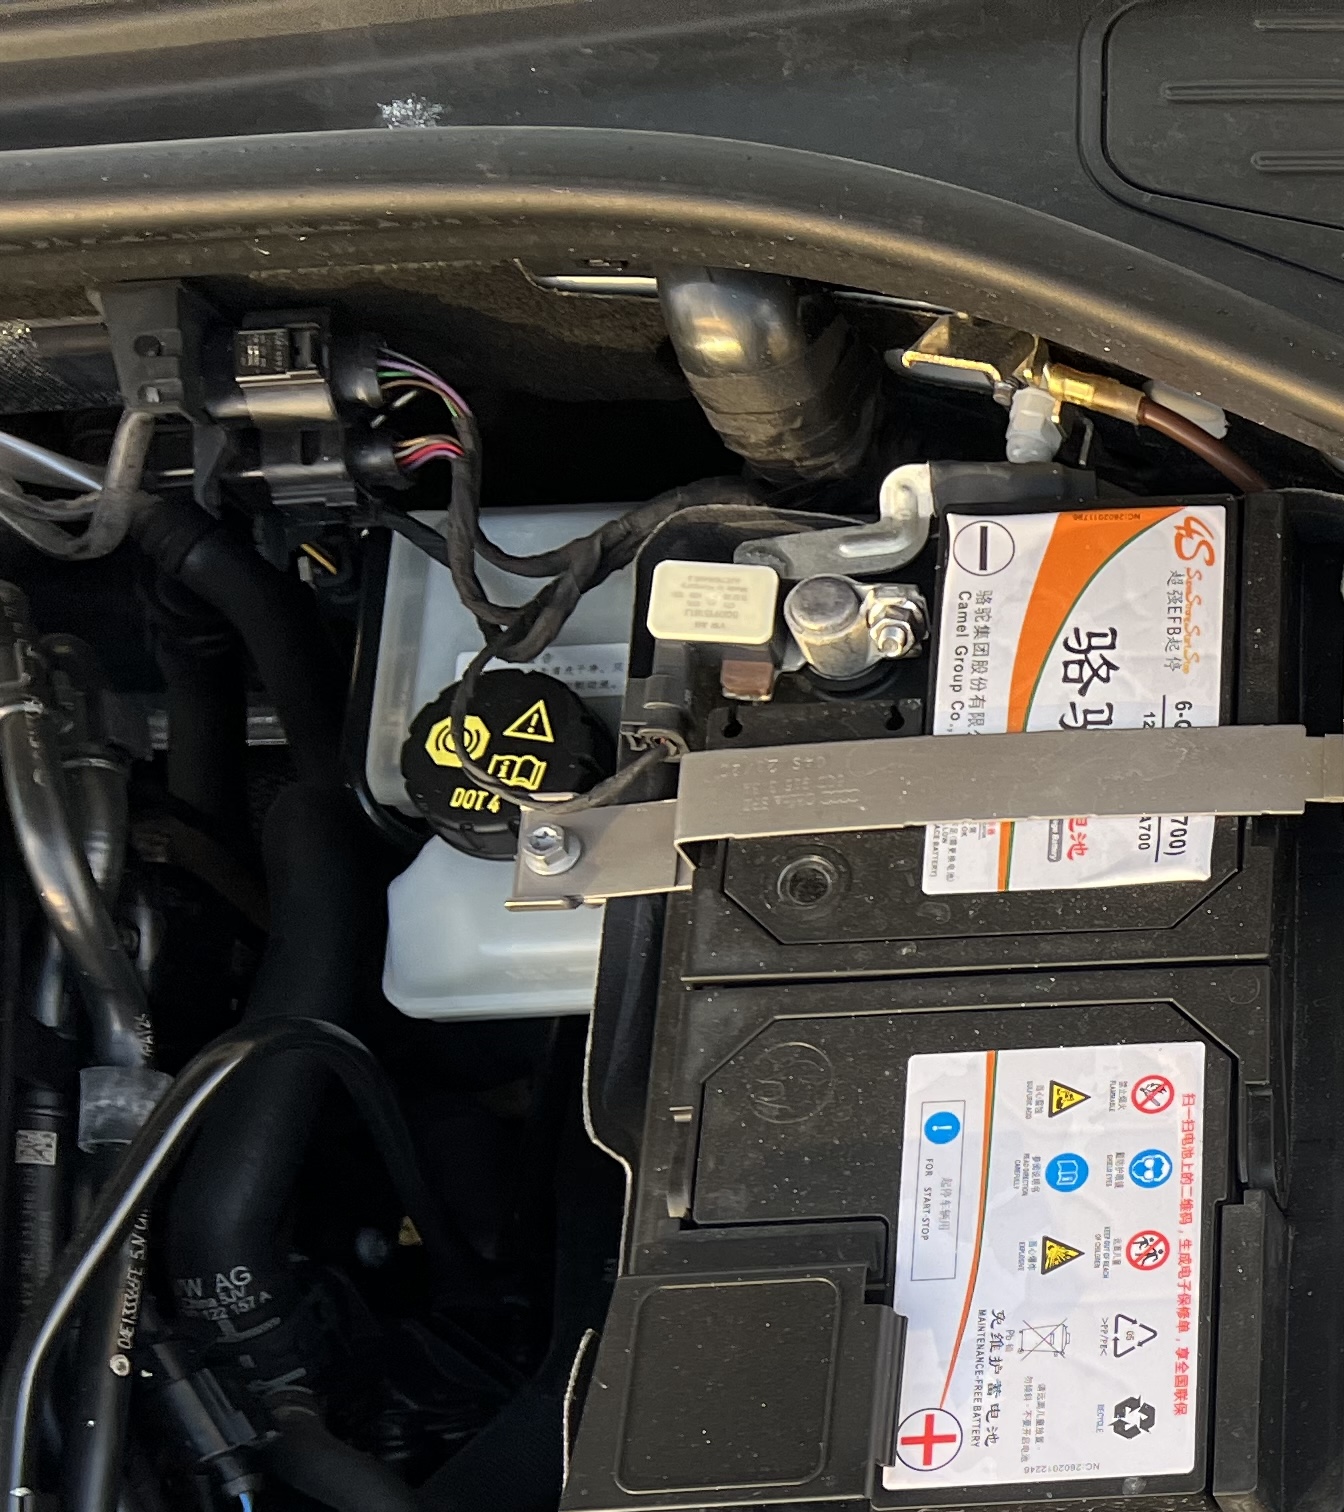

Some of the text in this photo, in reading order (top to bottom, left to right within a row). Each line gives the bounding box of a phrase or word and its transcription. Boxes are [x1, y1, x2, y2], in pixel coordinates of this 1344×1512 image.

[955, 590, 971, 638] Camel
[950, 645, 969, 693] Group
[449, 788, 501, 814] DOT 4
[920, 1158, 934, 1241] FOR START-STOP
[1173, 1092, 1196, 1417] 扫一扫电池上的二维码，生成电子保修单，享全国联保
[215, 1266, 252, 1292] AG
[1005, 1329, 1015, 1341] Pb
[984, 1309, 1006, 1448] 免维护蓄电池
[970, 1405, 982, 1448] BATTERY
